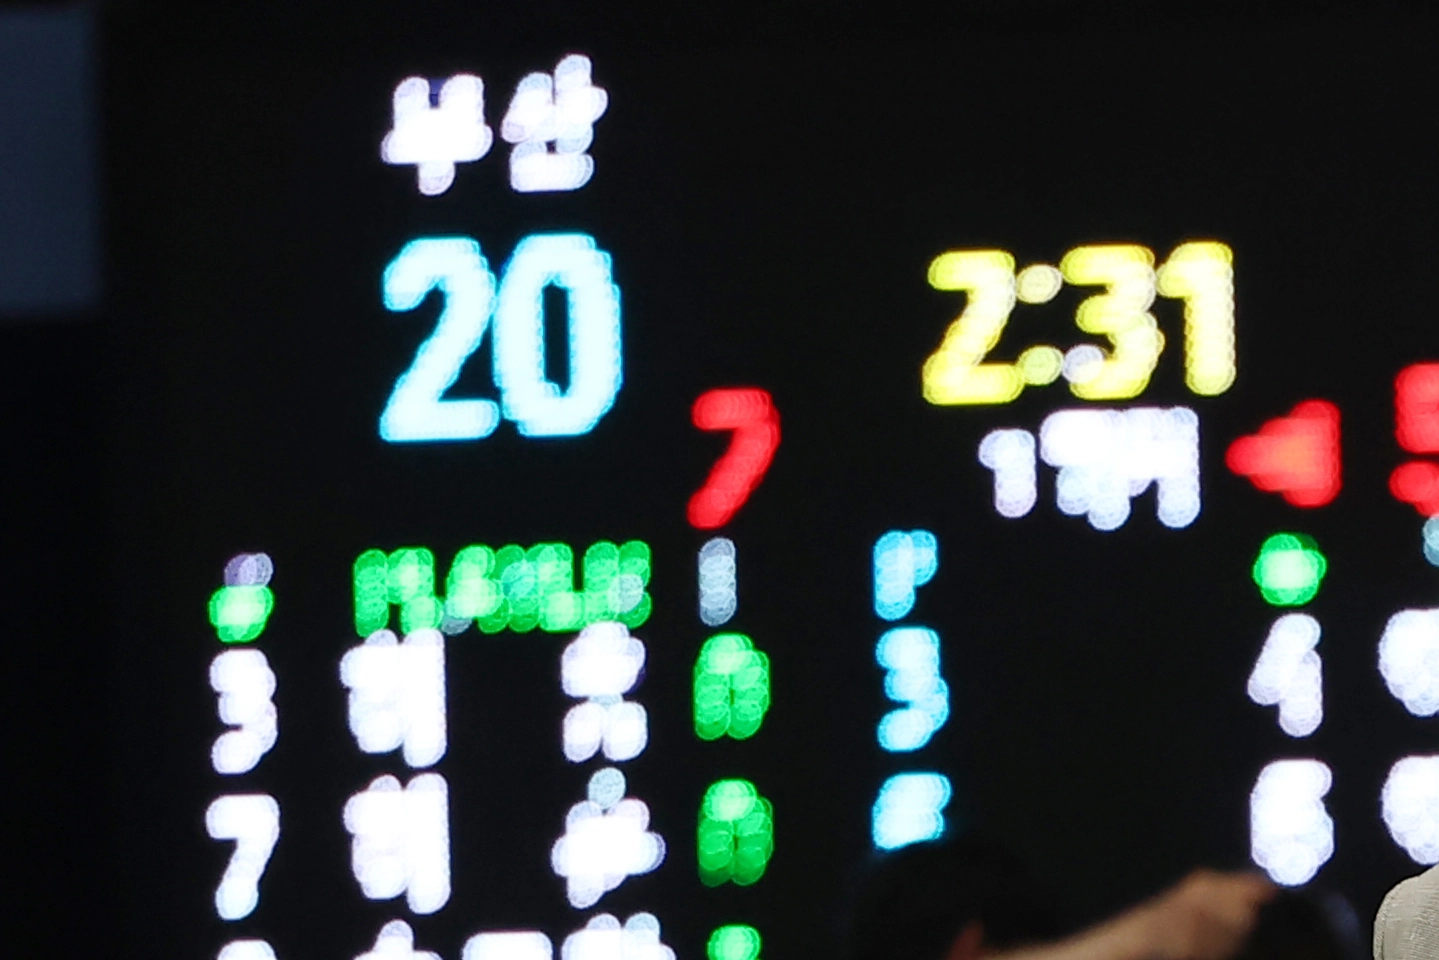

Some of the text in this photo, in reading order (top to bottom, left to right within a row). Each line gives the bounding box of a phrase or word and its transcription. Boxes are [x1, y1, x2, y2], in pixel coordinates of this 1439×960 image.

[380, 54, 608, 196] 부산
[378, 231, 625, 444] 20
[922, 240, 1236, 406] 2:31
[687, 387, 781, 530] 7
[209, 648, 278, 776] 3
[874, 625, 951, 753] 3
[1247, 613, 1323, 738] 4
[205, 793, 280, 921] 7
[1245, 758, 1335, 890] 6
